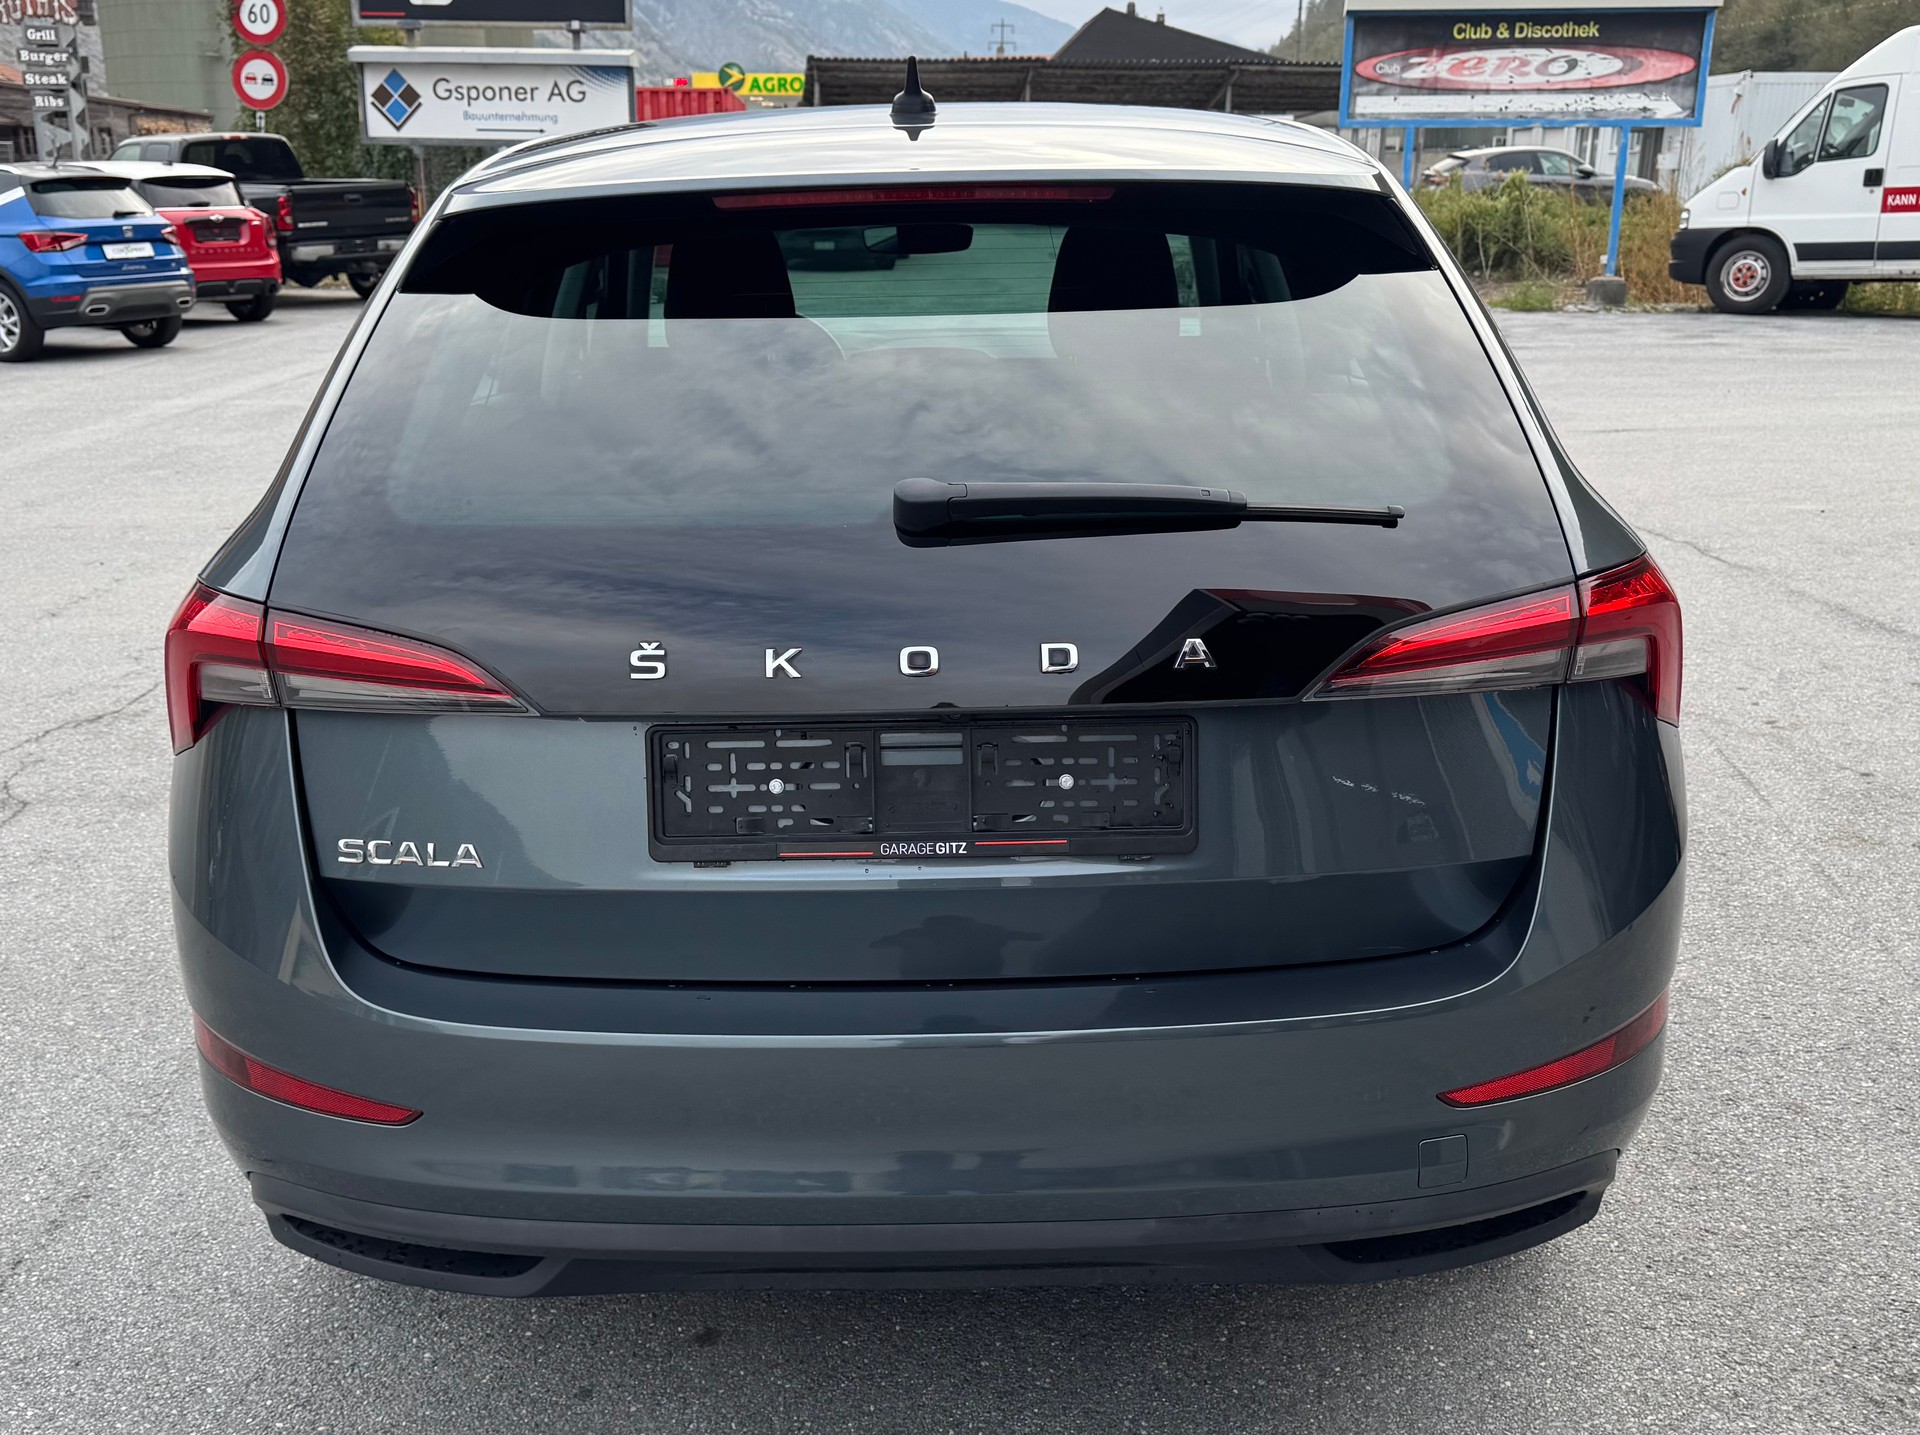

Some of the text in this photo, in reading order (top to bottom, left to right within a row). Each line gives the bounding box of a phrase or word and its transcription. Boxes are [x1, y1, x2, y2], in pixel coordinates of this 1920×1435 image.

[247, 3, 270, 24] 60
[26, 28, 56, 41] Grill
[1452, 21, 1601, 40] Club & Discothek
[19, 49, 69, 66] Burger
[1375, 62, 1401, 74] Club
[24, 72, 68, 85] Steak
[748, 76, 804, 93] AGRO
[431, 77, 587, 107] Gsponer AG
[33, 95, 65, 108] Ribs
[462, 110, 559, 124] Bauunternehmung
[1887, 193, 1917, 206] KANN
[337, 838, 484, 869] SCALA
